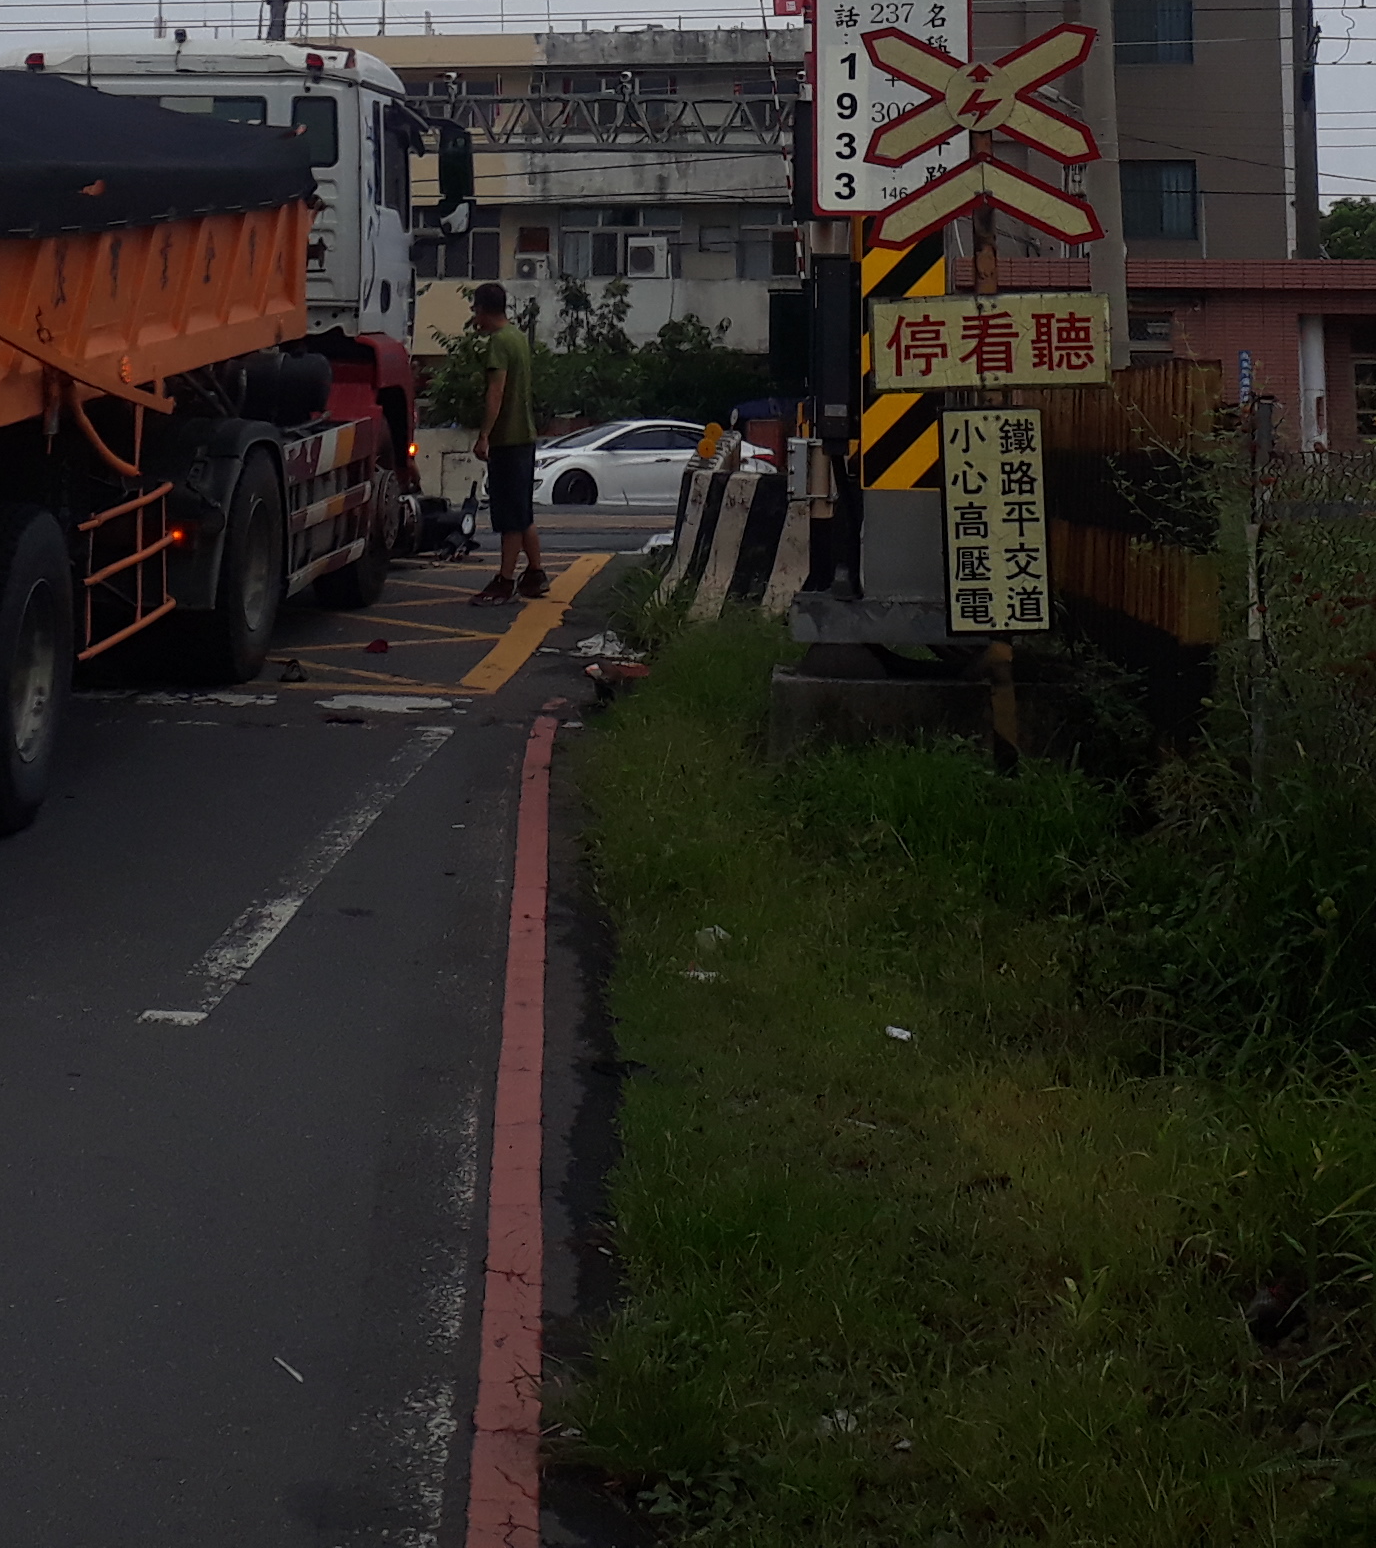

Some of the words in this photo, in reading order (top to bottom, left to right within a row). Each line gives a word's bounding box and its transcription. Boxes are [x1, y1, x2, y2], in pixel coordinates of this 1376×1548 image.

[870, 3, 914, 24] 237
[834, 52, 858, 201] 1933
[886, 311, 1096, 377] 停看聽
[949, 419, 995, 625] 小心高壓電
[997, 418, 1045, 624] 鐵路平交道
